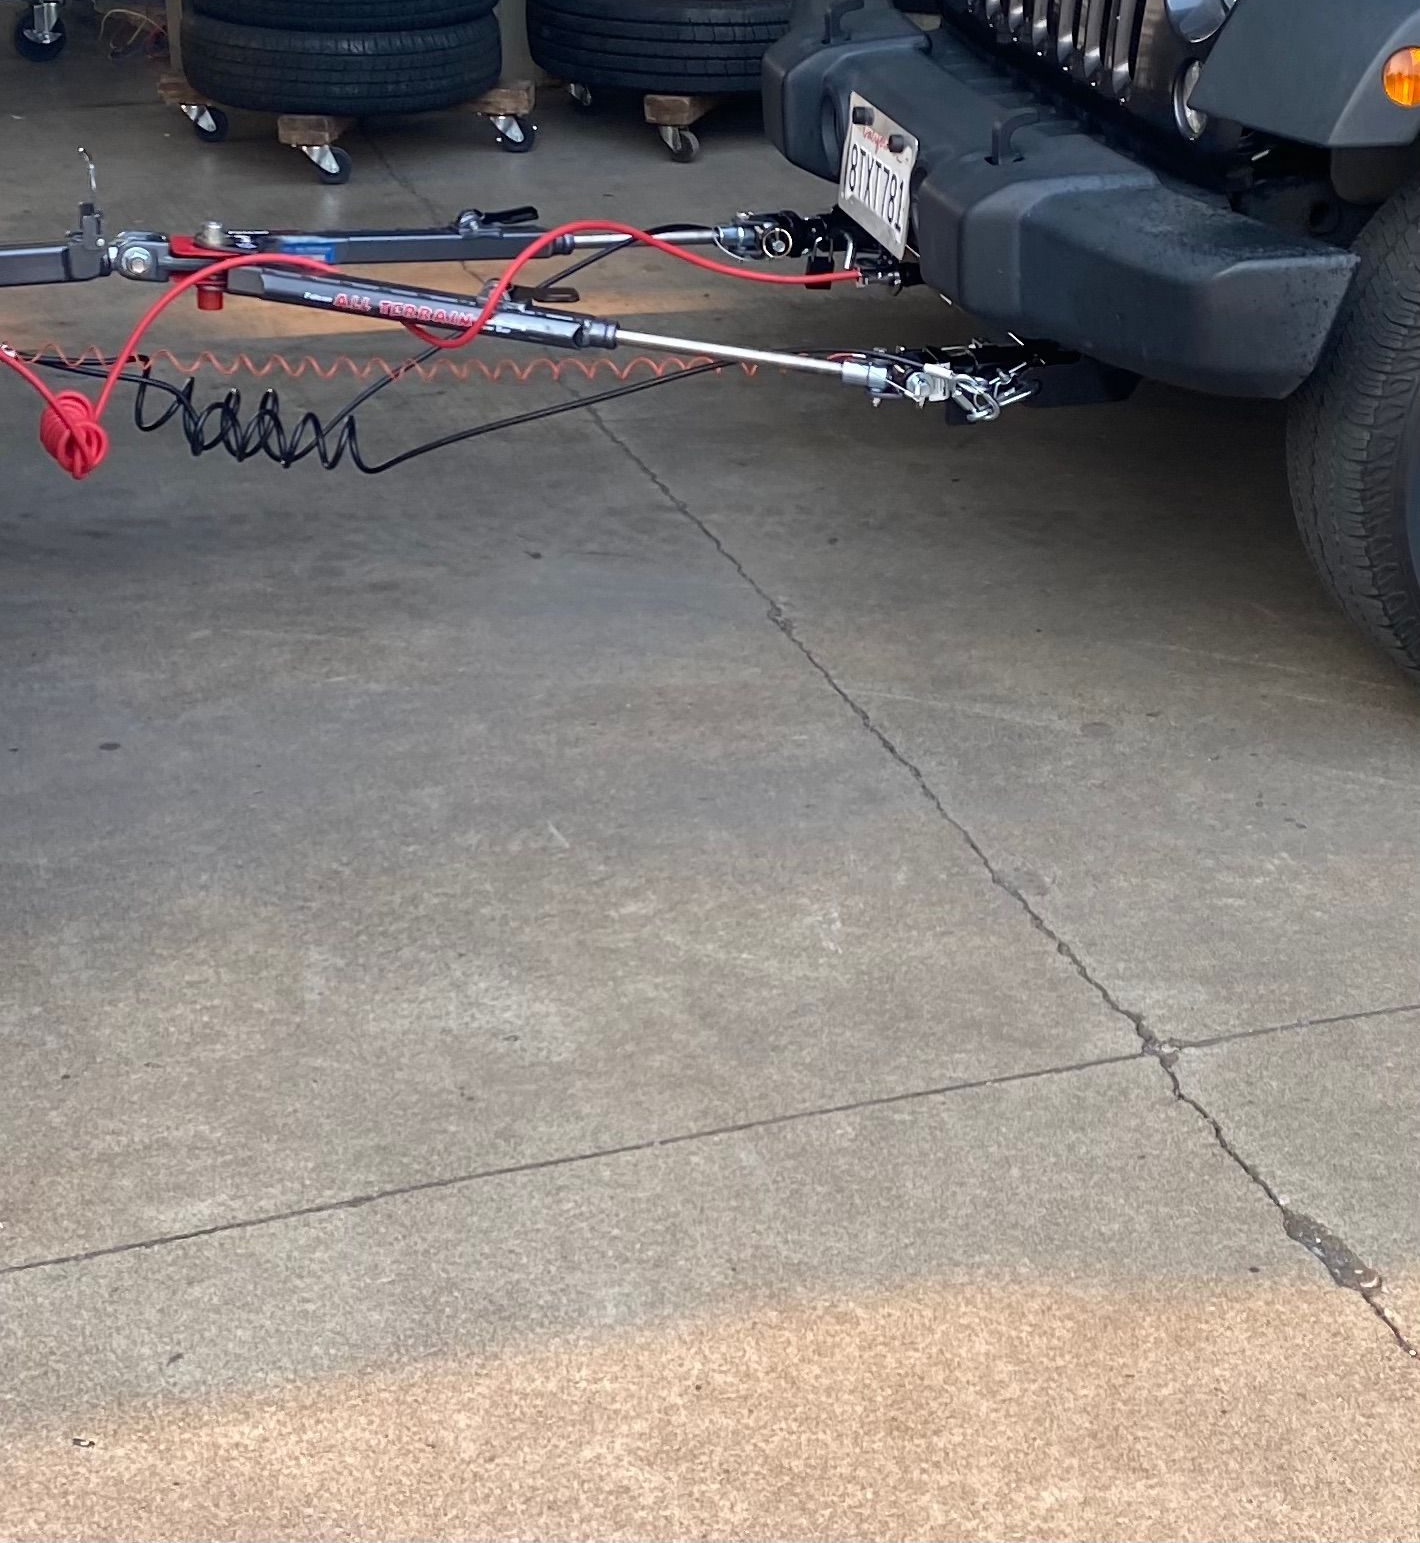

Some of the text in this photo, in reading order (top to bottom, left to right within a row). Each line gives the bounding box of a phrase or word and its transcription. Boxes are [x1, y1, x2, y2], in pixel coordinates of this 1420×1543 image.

[849, 143, 904, 232] 8TXT781
[332, 292, 372, 312] ALL
[378, 299, 474, 327] TERRAIN
